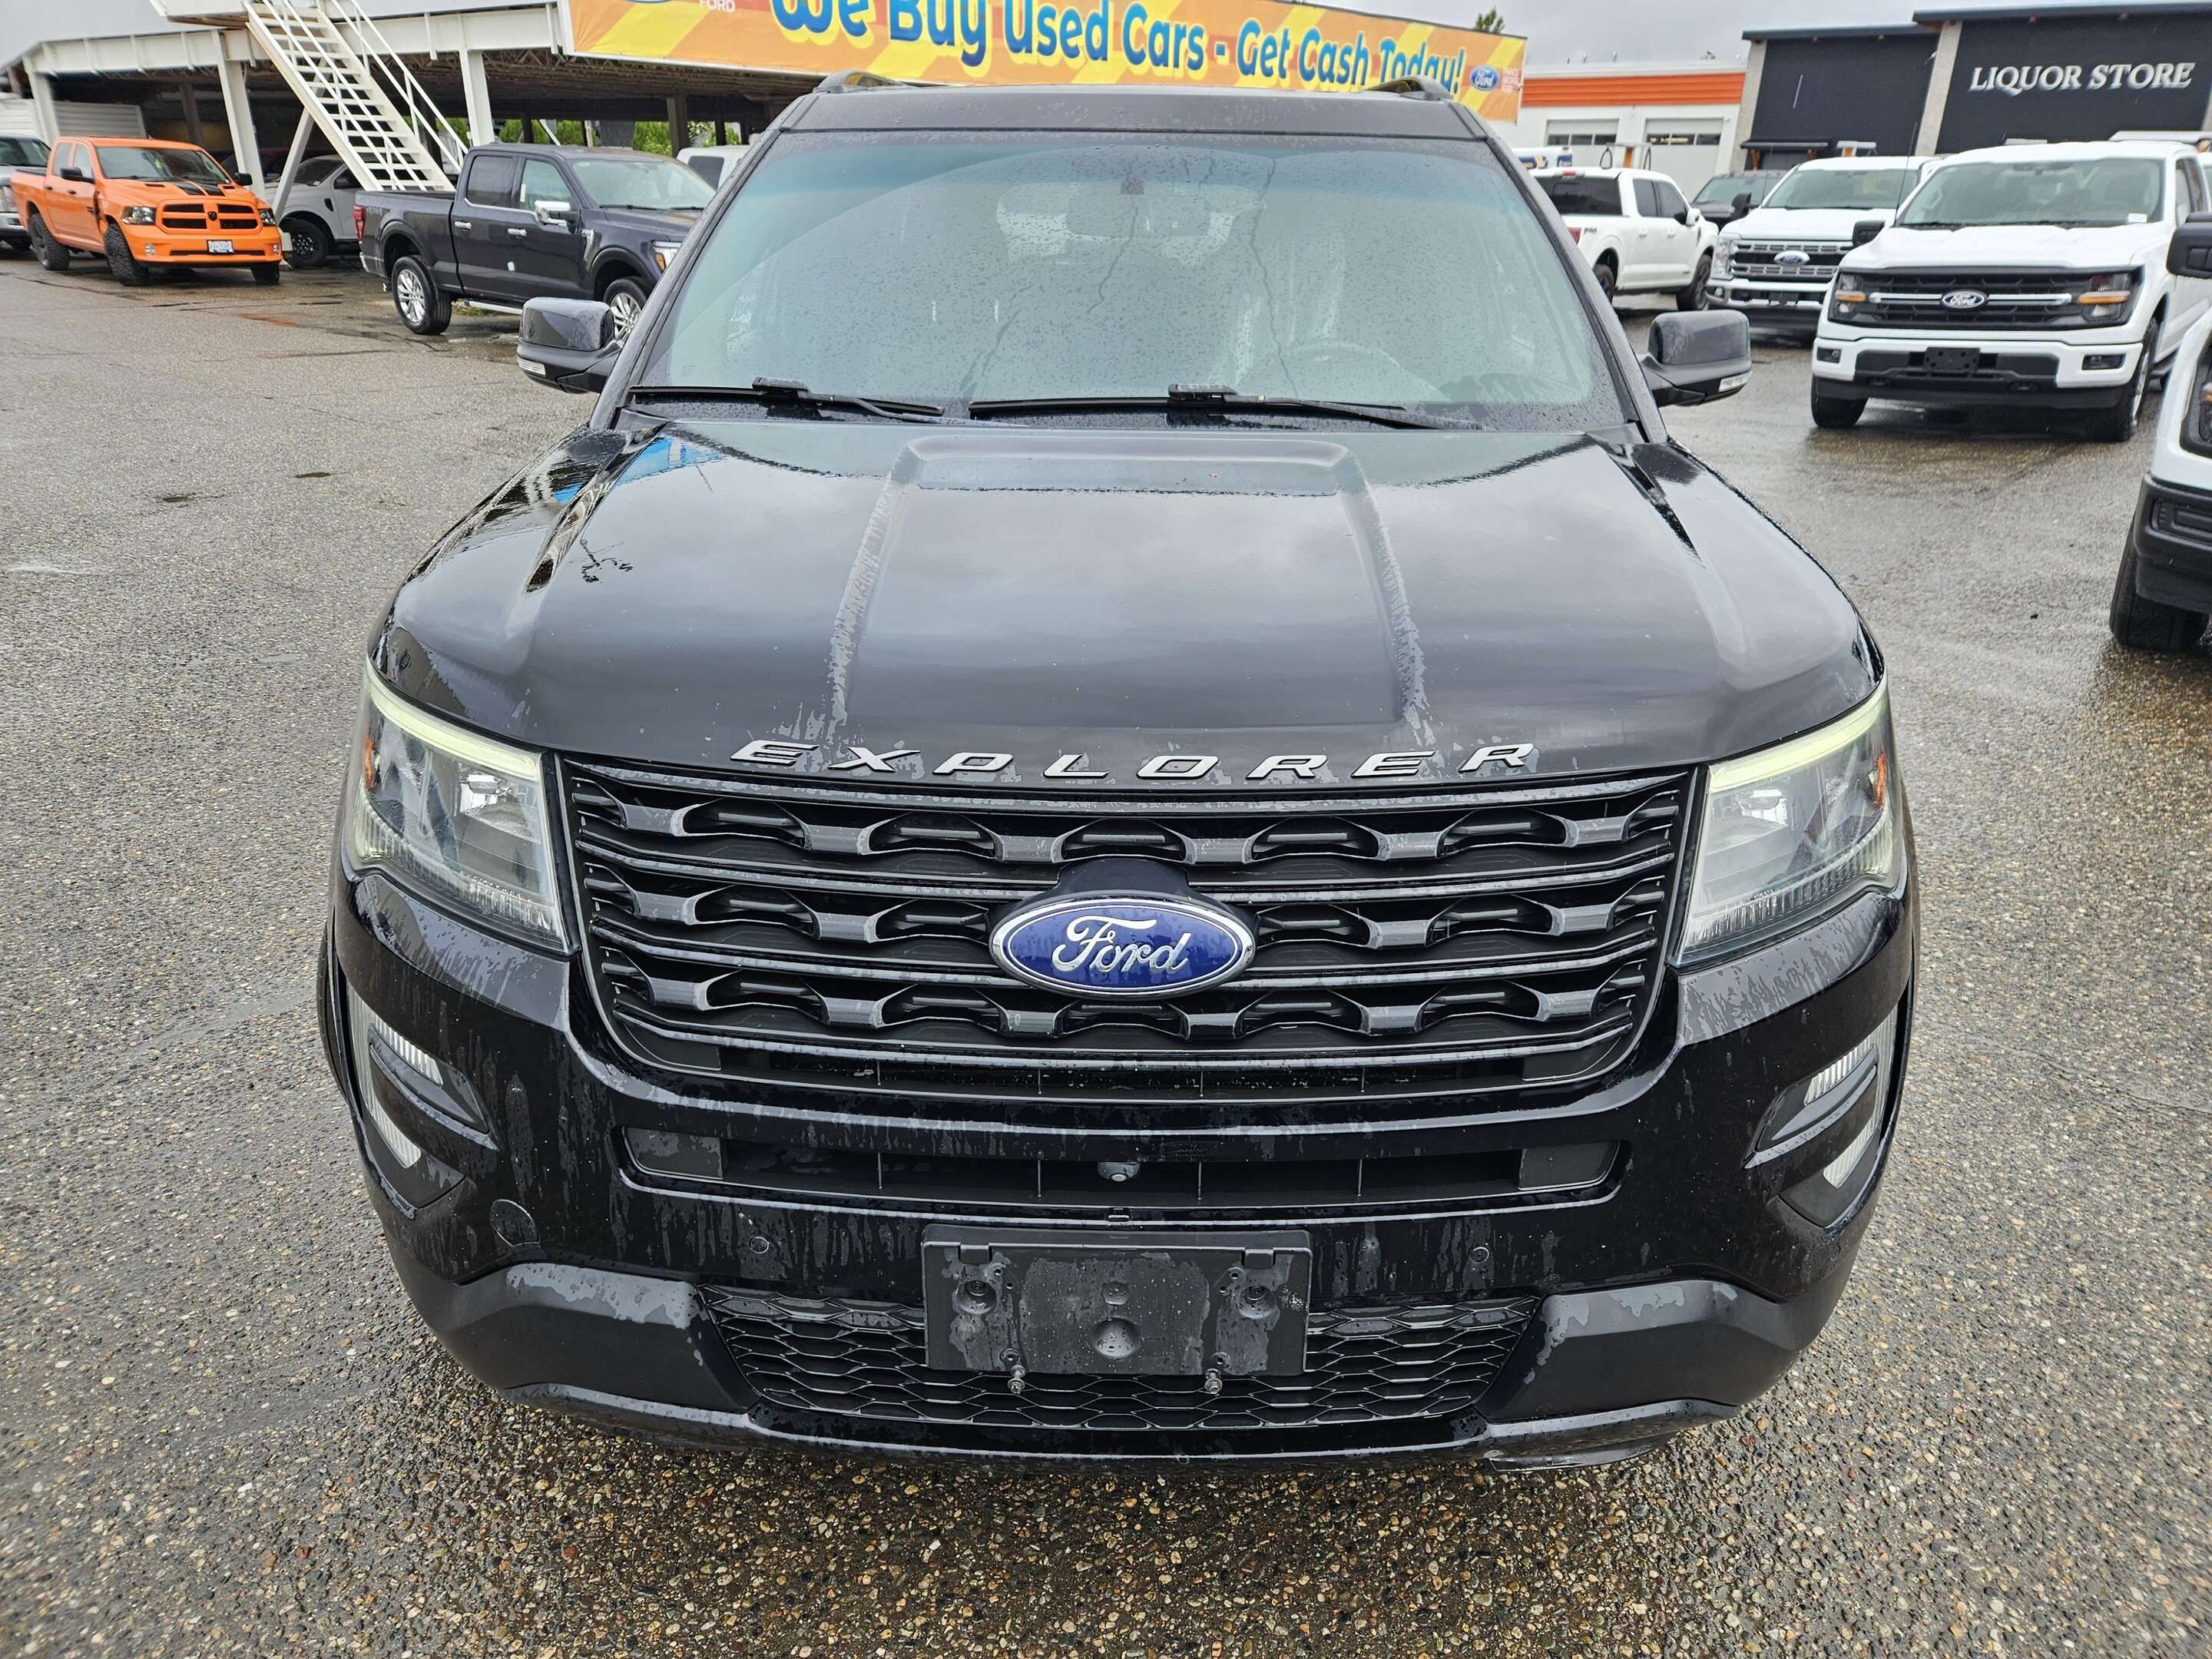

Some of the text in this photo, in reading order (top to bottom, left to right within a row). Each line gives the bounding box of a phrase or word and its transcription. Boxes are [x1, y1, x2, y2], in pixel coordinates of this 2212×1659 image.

[700, 0, 736, 12] FORD
[889, 0, 986, 66] Buy
[1004, 0, 1108, 61] Used
[1122, 5, 1204, 71] Cars
[1237, 19, 1290, 78] Get
[1299, 28, 1369, 85] Cash
[1379, 38, 1465, 94] Today!
[1967, 61, 2195, 97] LIQUOR STORE
[730, 739, 1535, 780] EXPLORER
[1051, 915, 1192, 975] Ford
